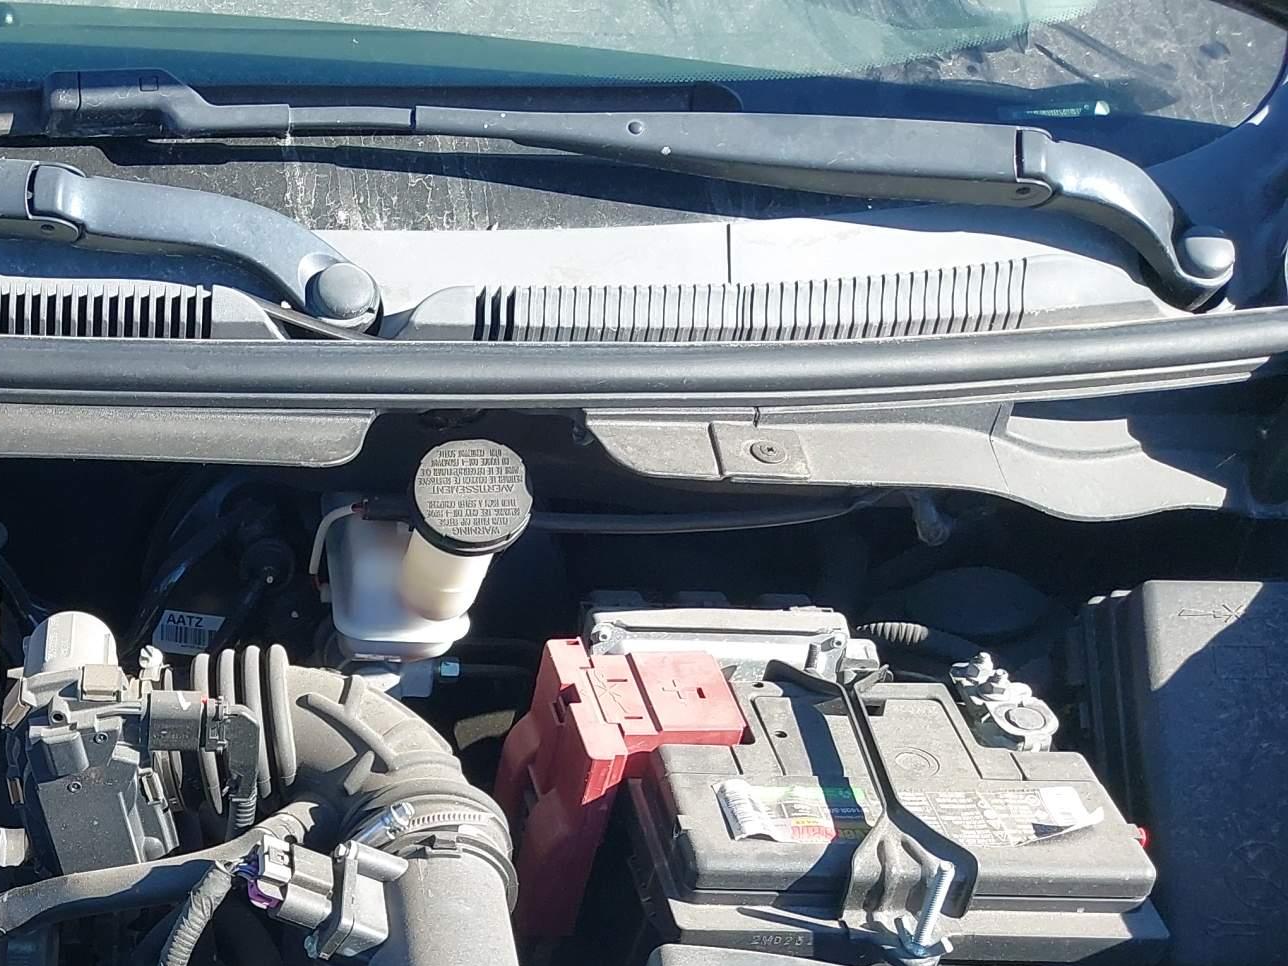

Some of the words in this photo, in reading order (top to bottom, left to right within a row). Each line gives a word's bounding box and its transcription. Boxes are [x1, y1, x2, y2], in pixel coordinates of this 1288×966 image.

[431, 484, 514, 494] AVERTISSEMENT
[452, 527, 499, 535] WARNING
[167, 614, 204, 628] AATZ
